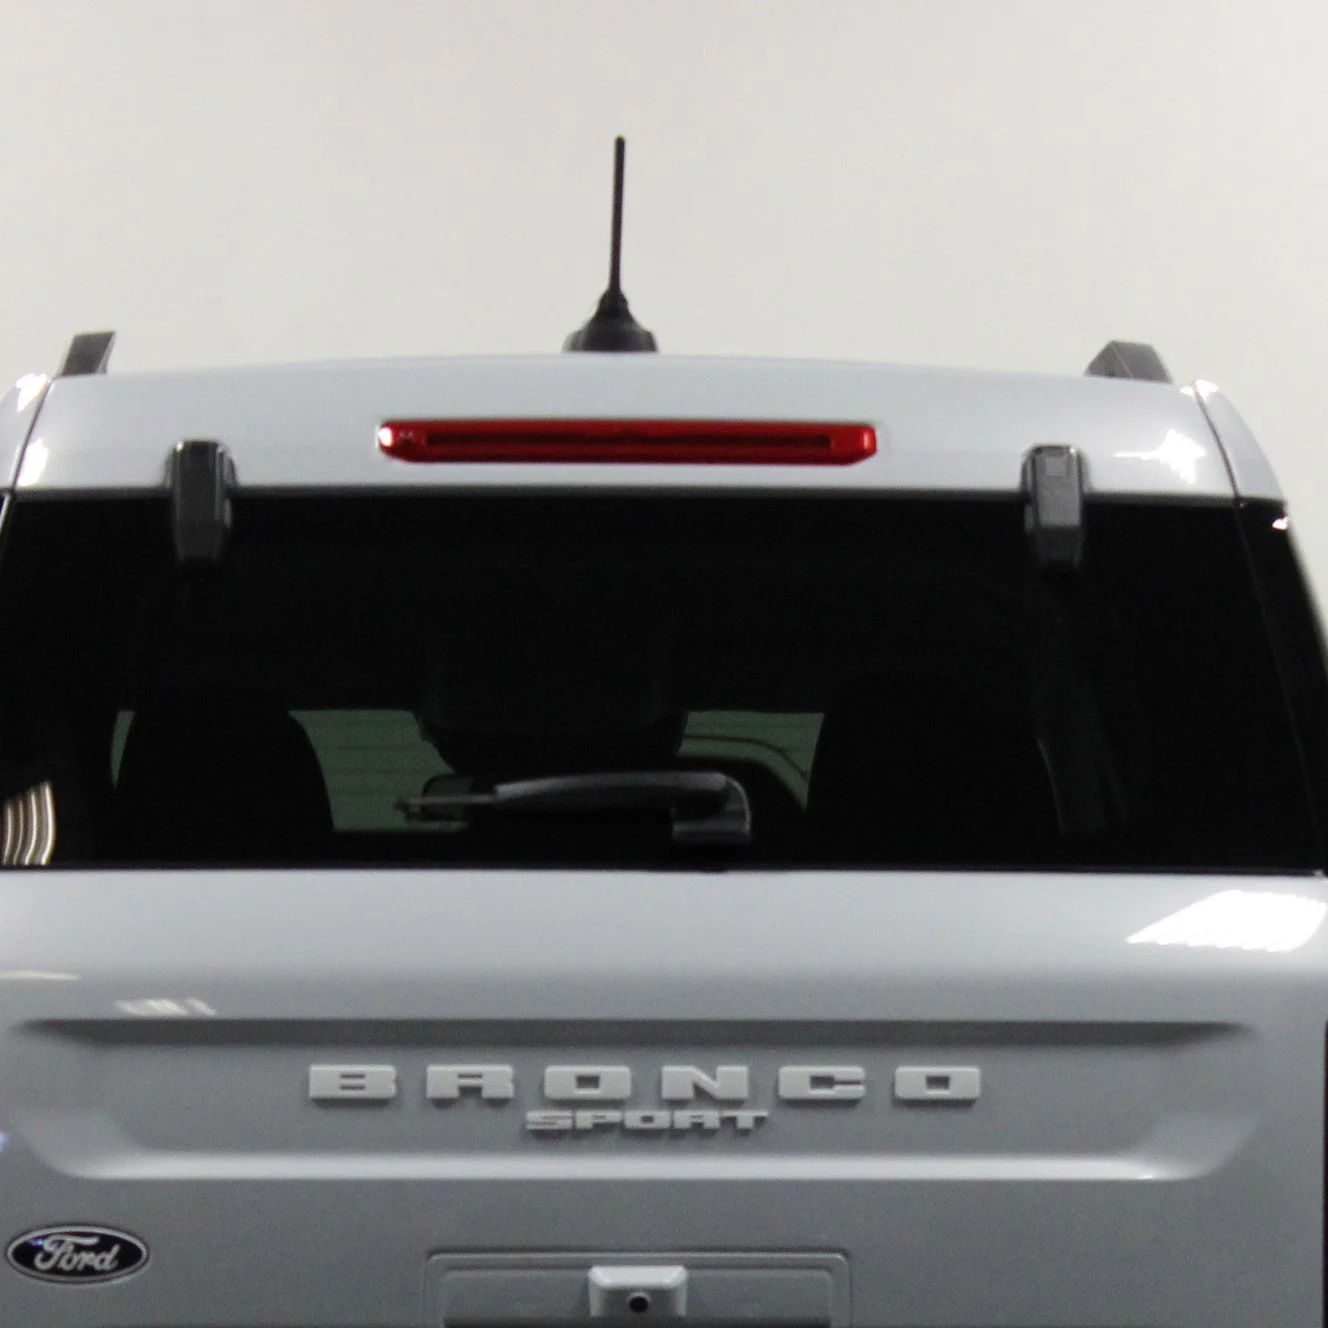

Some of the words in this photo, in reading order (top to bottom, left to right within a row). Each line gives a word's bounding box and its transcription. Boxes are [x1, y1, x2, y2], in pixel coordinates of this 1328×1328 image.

[308, 1064, 982, 1100] BRONCO
[526, 1109, 768, 1131] SPORT
[33, 1234, 121, 1271] Ford
